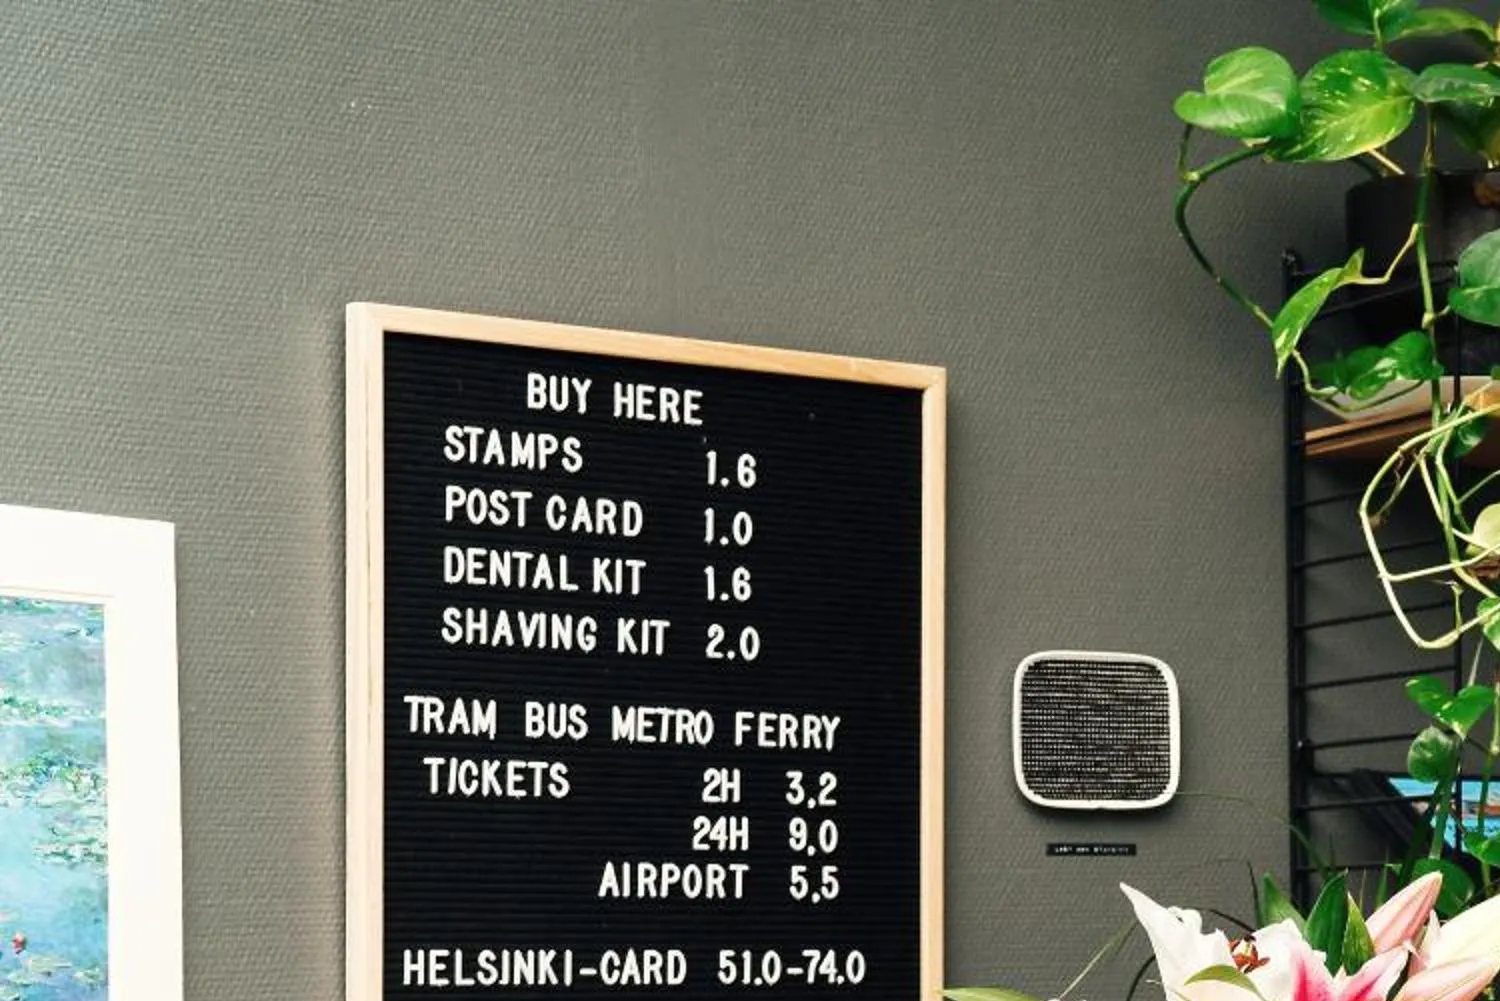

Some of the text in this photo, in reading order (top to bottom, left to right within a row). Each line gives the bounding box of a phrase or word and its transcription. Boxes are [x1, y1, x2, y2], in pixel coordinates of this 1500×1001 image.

[527, 372, 703, 425] BUY HERE
[444, 425, 757, 488] STAMPS 1.6
[445, 485, 753, 545] POST CARD 1.0
[444, 546, 752, 601] DENTAL KIT 1.6
[441, 607, 760, 660] SHAVING KIT 2.0
[404, 695, 841, 751] TRAM BUS METRO FERRY
[423, 757, 570, 798] TICKETS
[702, 768, 741, 802] 2H
[693, 816, 749, 851] 24H
[598, 862, 750, 898] AIRPORT
[403, 948, 687, 986] HELSINKI-CARD
